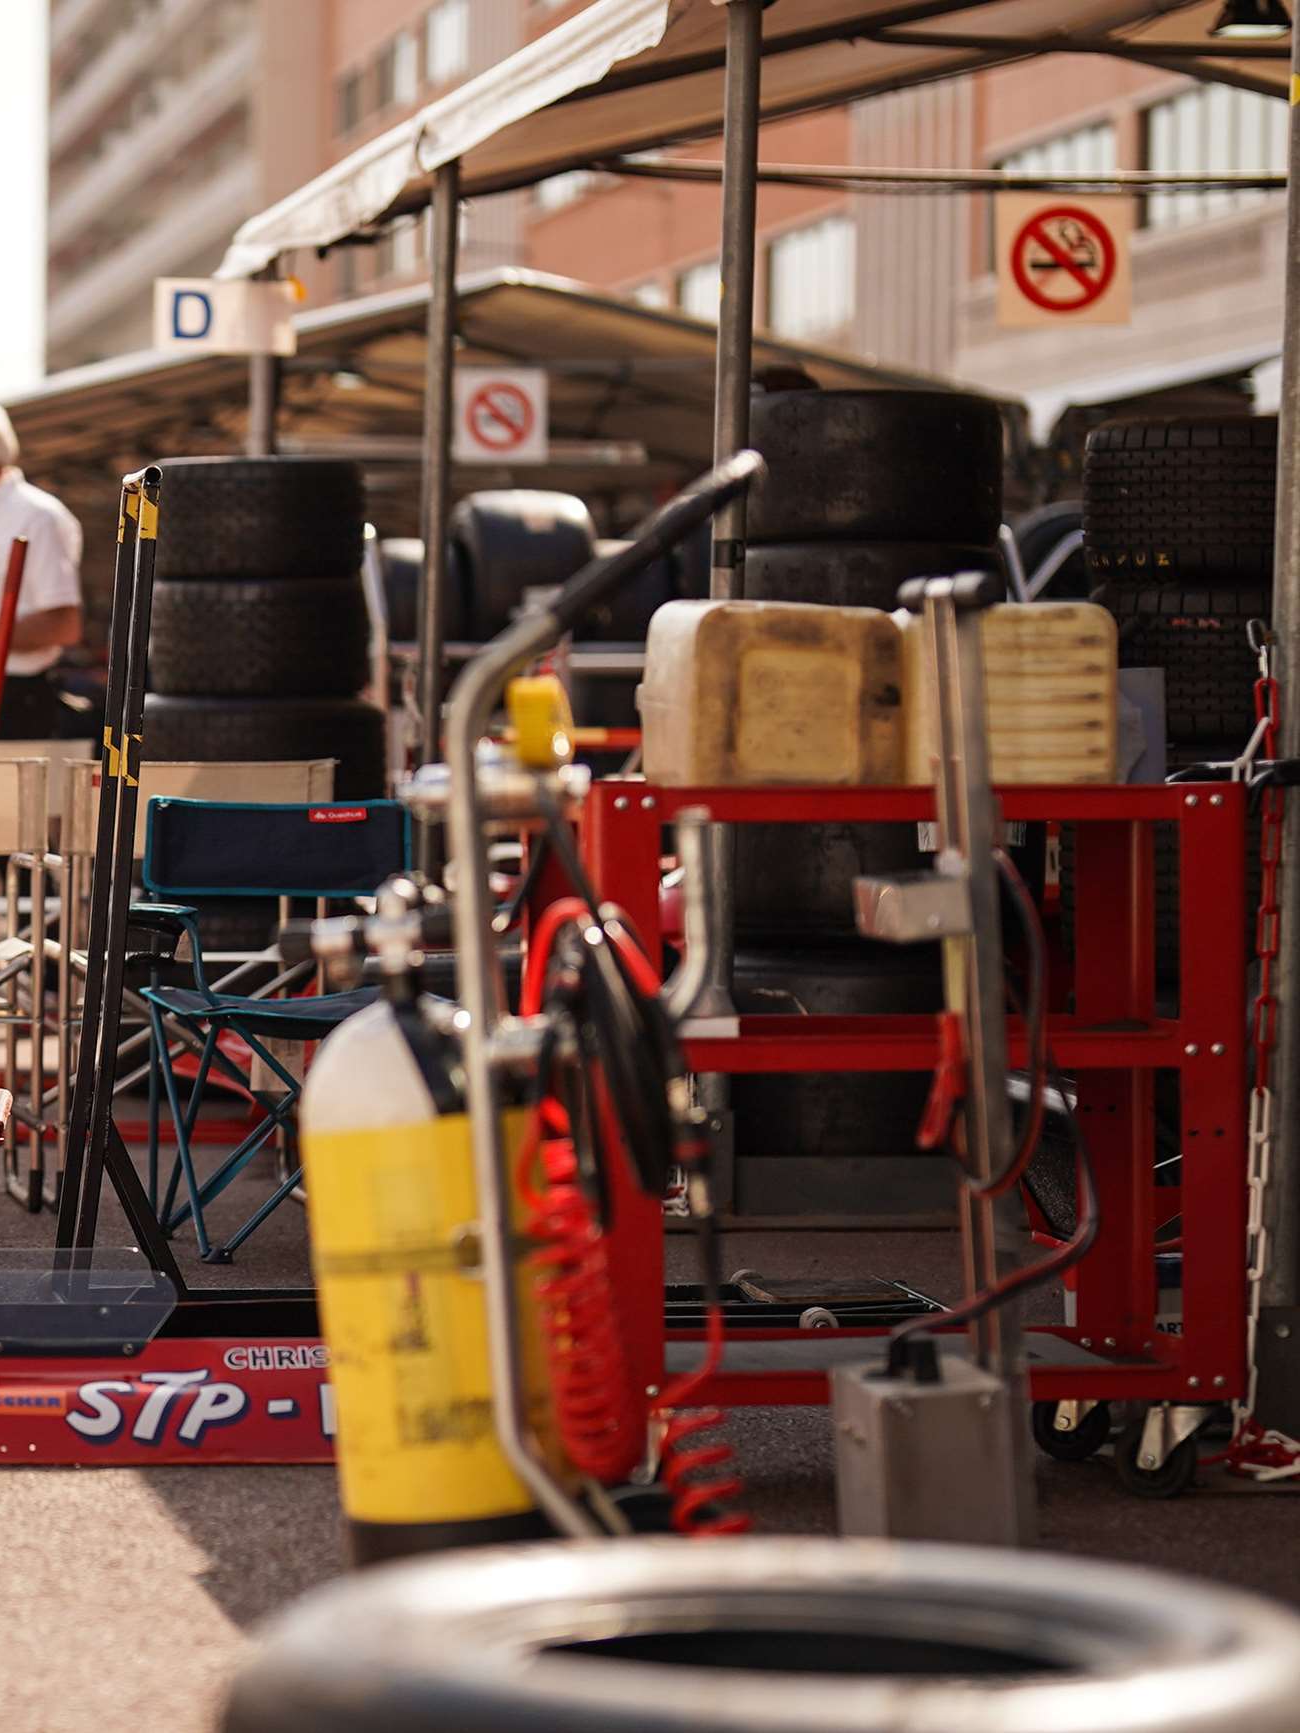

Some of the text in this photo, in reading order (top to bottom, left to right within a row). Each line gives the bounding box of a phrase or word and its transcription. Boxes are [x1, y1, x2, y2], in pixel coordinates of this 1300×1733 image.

[171, 290, 212, 339] D
[224, 1346, 331, 1370] CHRIS
[65, 1369, 249, 1447] STP
